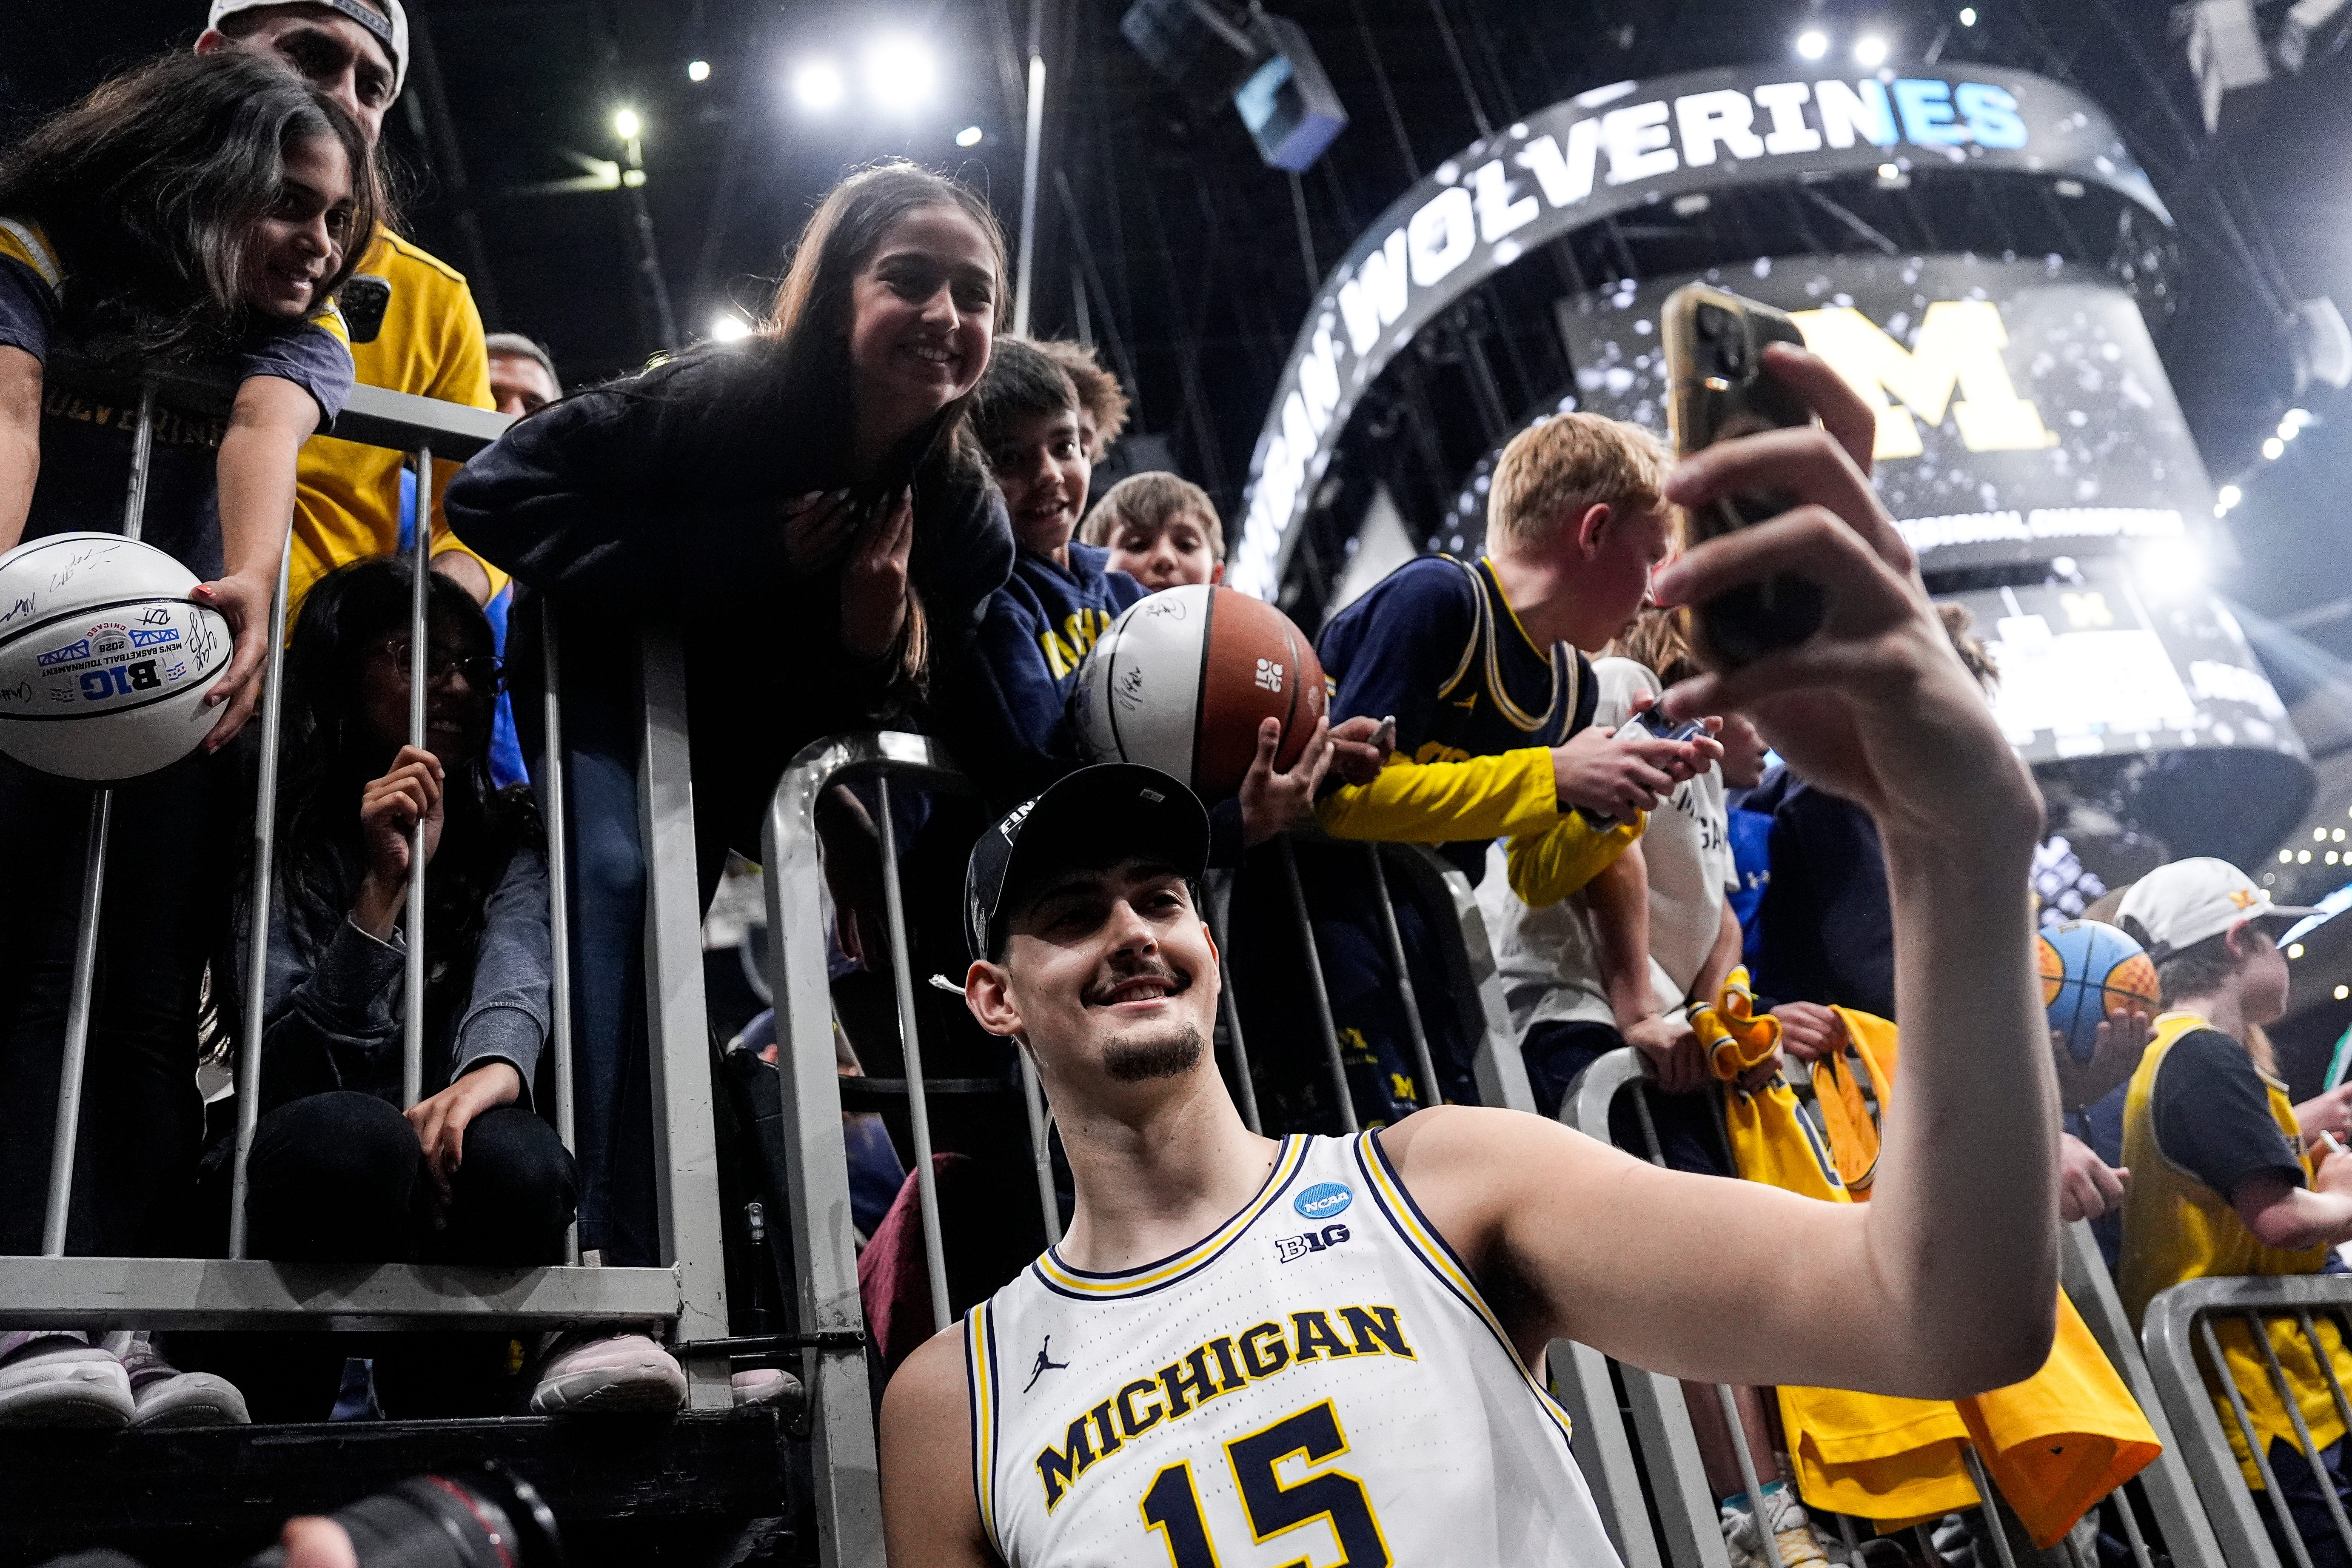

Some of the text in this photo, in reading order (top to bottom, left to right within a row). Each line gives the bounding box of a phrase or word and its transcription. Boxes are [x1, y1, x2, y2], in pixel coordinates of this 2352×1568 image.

[1337, 78, 2029, 356] WOLVERINES
[1788, 300, 2047, 462] M
[41, 642, 182, 677] MEN'S BASKETBALL TOURNAMENT
[87, 622, 126, 637] CHICAGO
[1304, 1192, 1350, 1213] NCAA
[1034, 1304, 1418, 1516] MICHIGAN
[1139, 1397, 1395, 1568] 15
